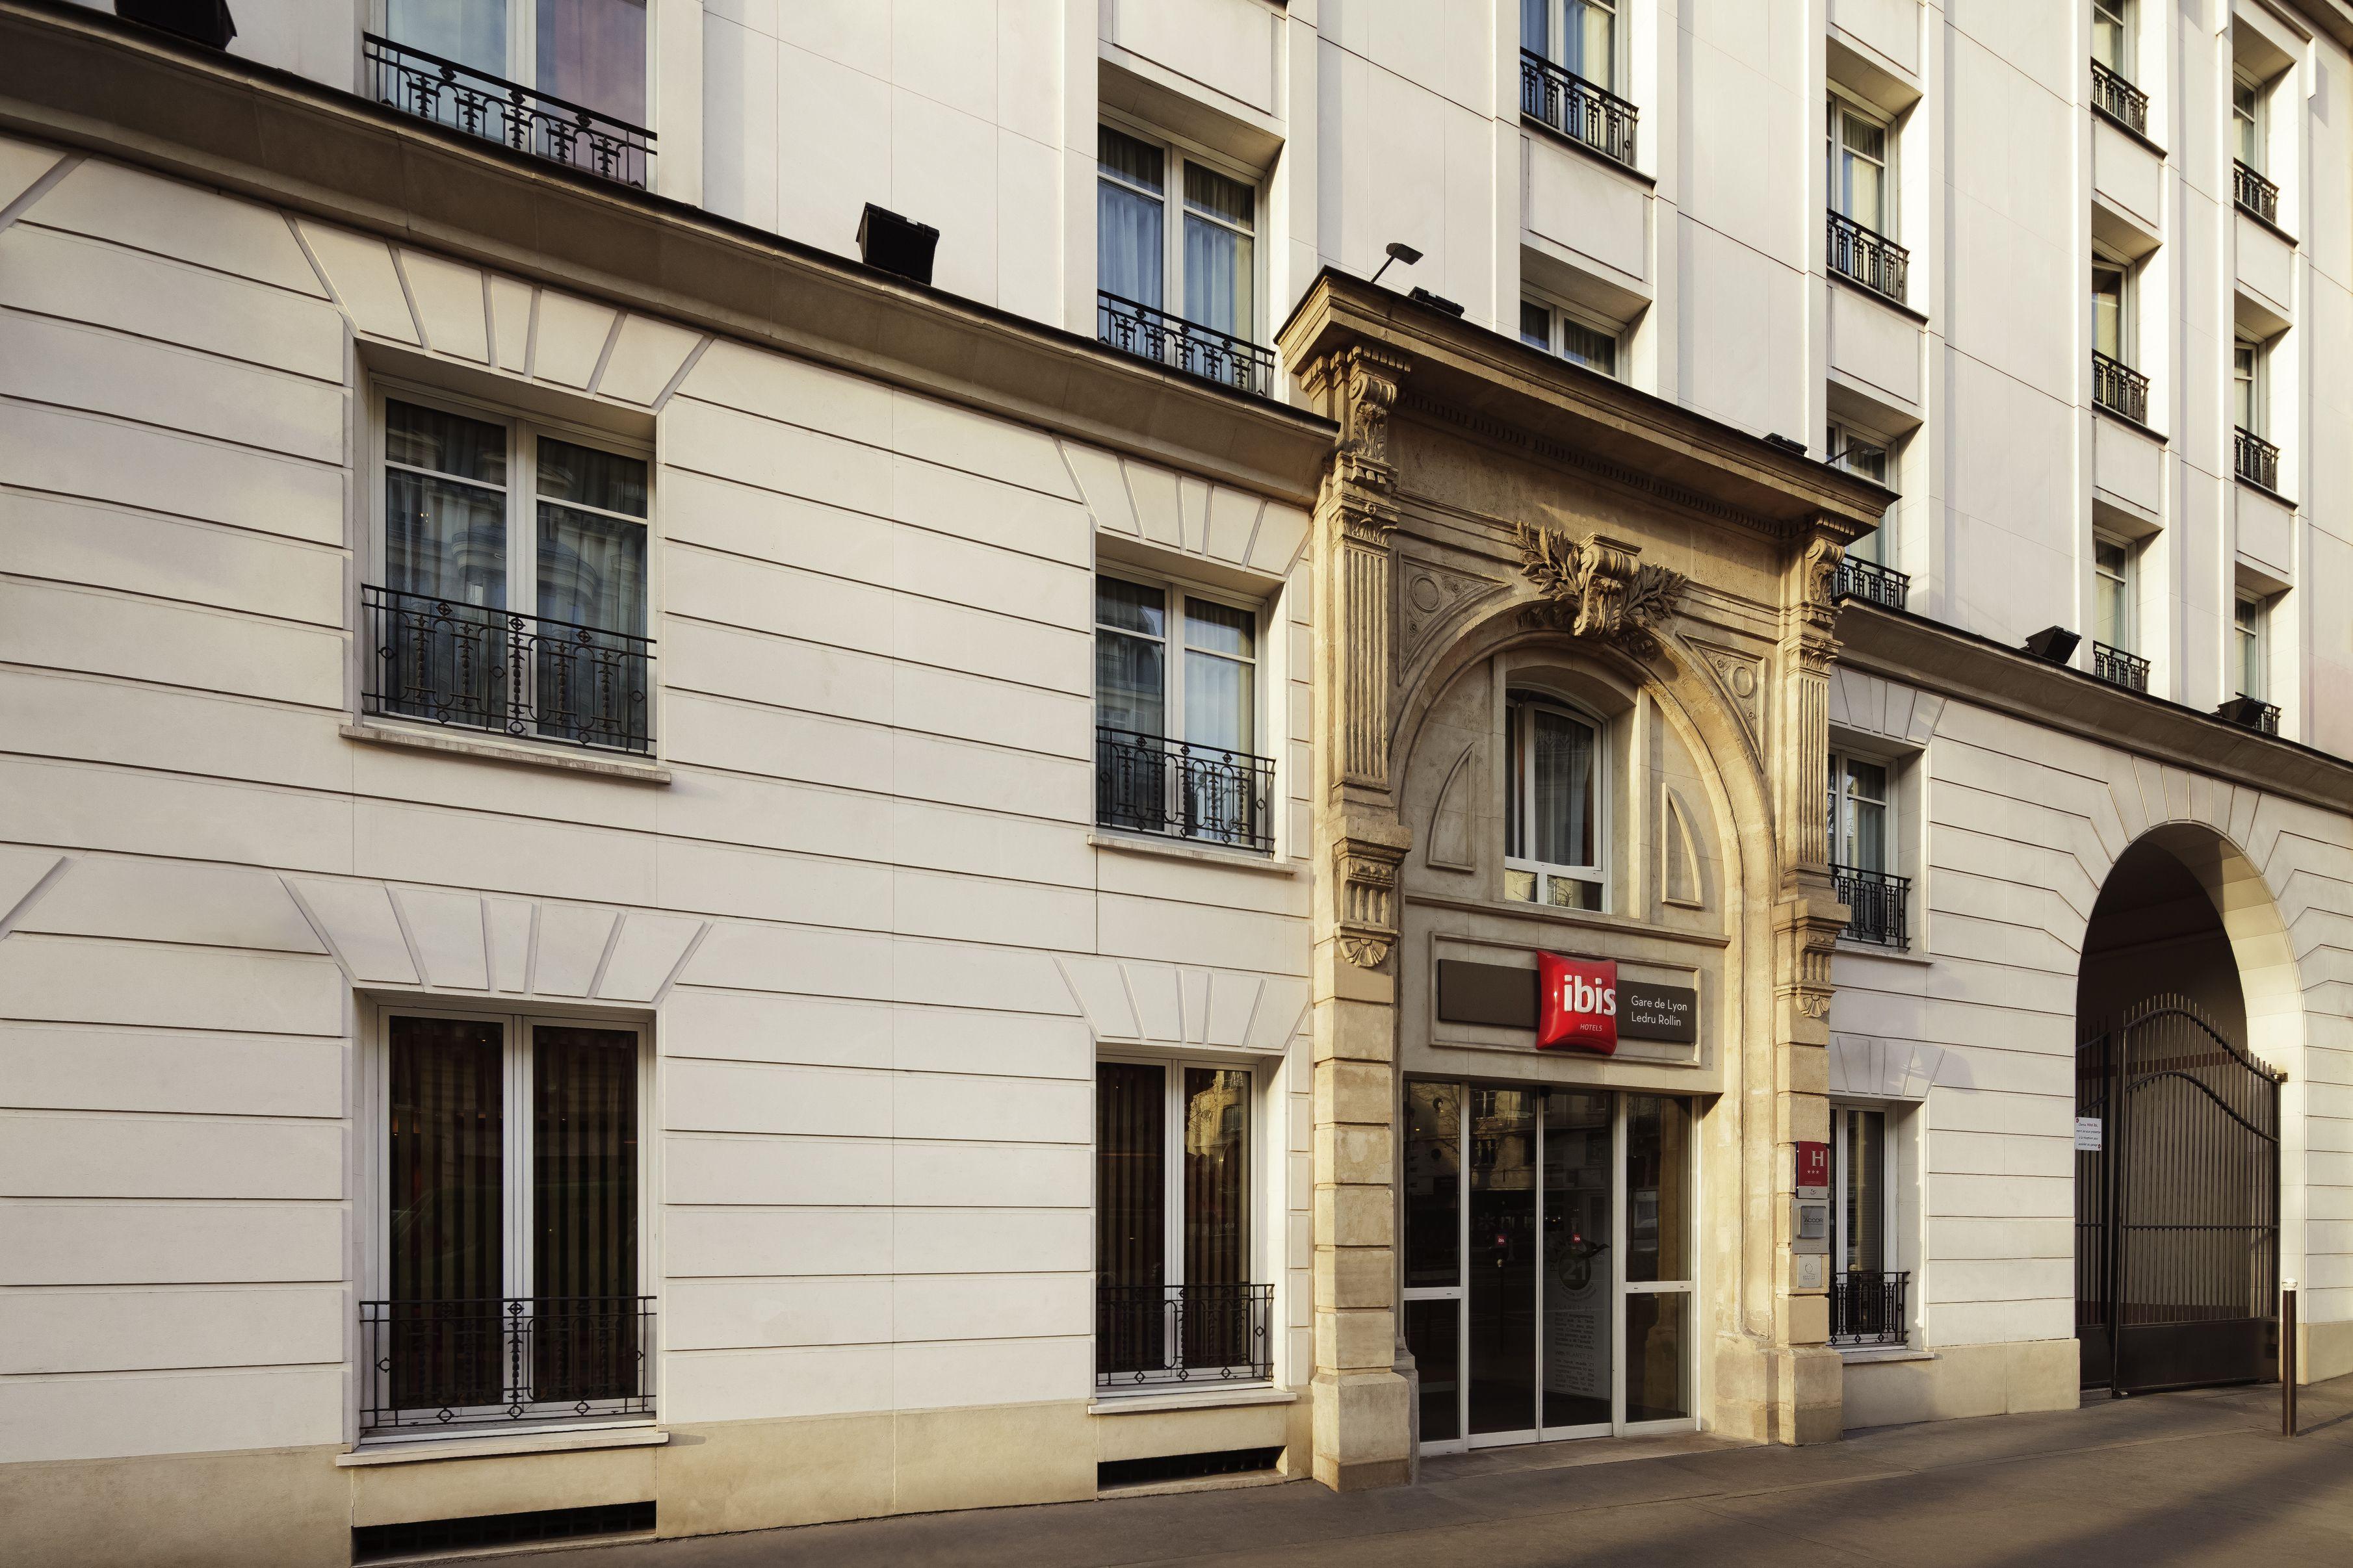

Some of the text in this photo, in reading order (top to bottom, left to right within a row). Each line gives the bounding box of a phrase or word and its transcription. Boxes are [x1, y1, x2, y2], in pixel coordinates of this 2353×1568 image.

[1564, 974, 1617, 1016] ibis
[1631, 996, 1687, 1012] Gare de Lyon
[1632, 1011, 1681, 1026] Ledru Rollin
[1812, 1150, 1825, 1167] H
[1563, 1259, 1587, 1280] 21
